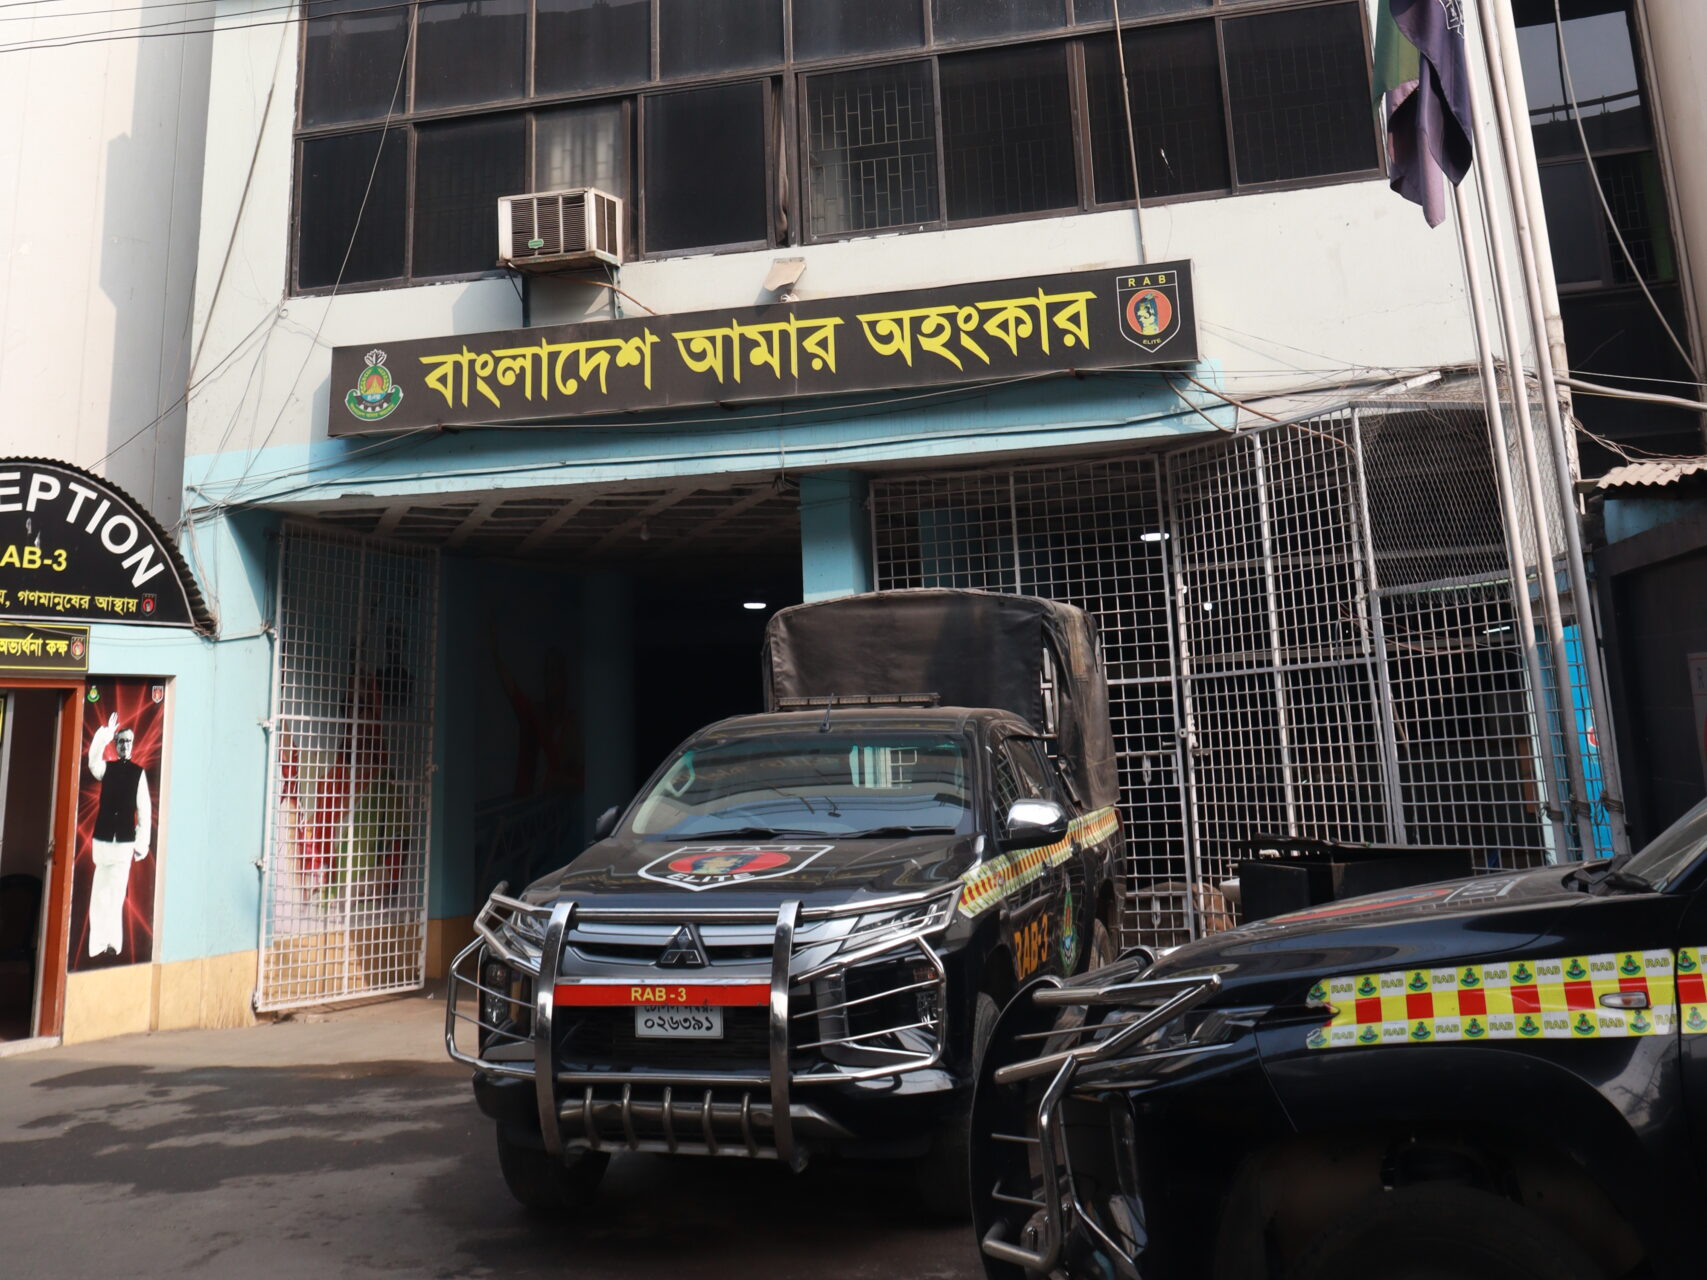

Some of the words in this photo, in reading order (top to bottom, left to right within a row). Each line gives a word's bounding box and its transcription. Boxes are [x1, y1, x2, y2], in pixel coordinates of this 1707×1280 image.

[1128, 274, 1166, 287] RAB
[419, 327, 659, 409] বাংলাদেশ
[673, 312, 844, 384] আমার
[859, 288, 1096, 372] অহংকার
[0, 471, 165, 589] EPTION
[0, 545, 68, 571] AB-3
[17, 589, 91, 612] গণমানুষের
[45, 639, 69, 657] কক্ষ
[666, 872, 755, 883] ELITE
[631, 987, 667, 1002] RAB
[644, 1015, 714, 1032] ০২৬৩৯১
